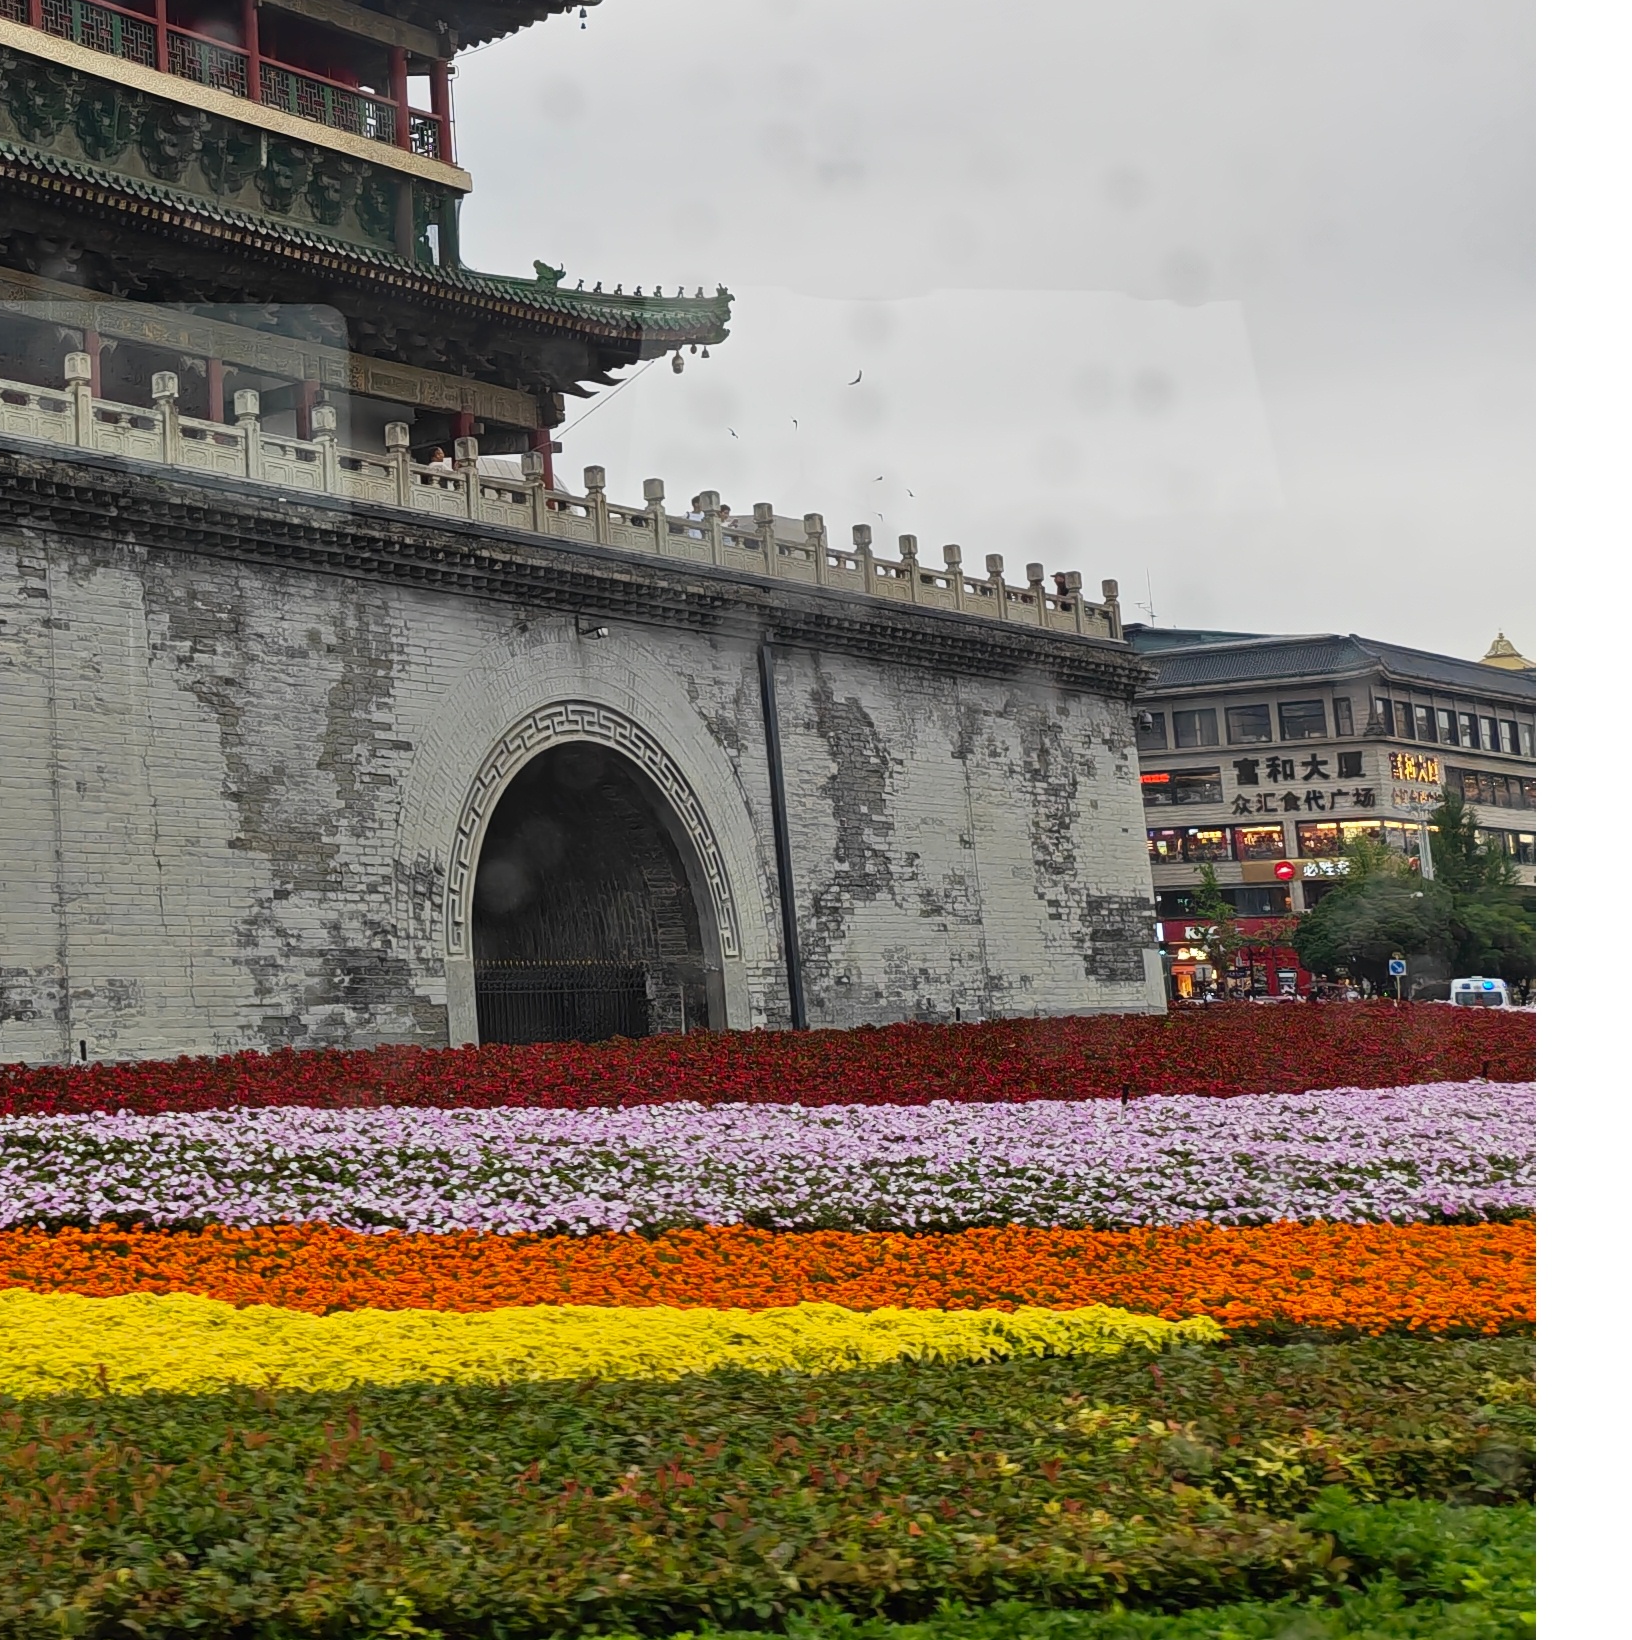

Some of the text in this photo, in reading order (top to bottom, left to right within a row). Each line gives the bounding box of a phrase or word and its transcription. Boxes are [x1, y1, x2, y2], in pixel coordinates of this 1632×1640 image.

[1233, 751, 1366, 786] 富和大厦
[1231, 788, 1376, 815] 众汇食代广场
